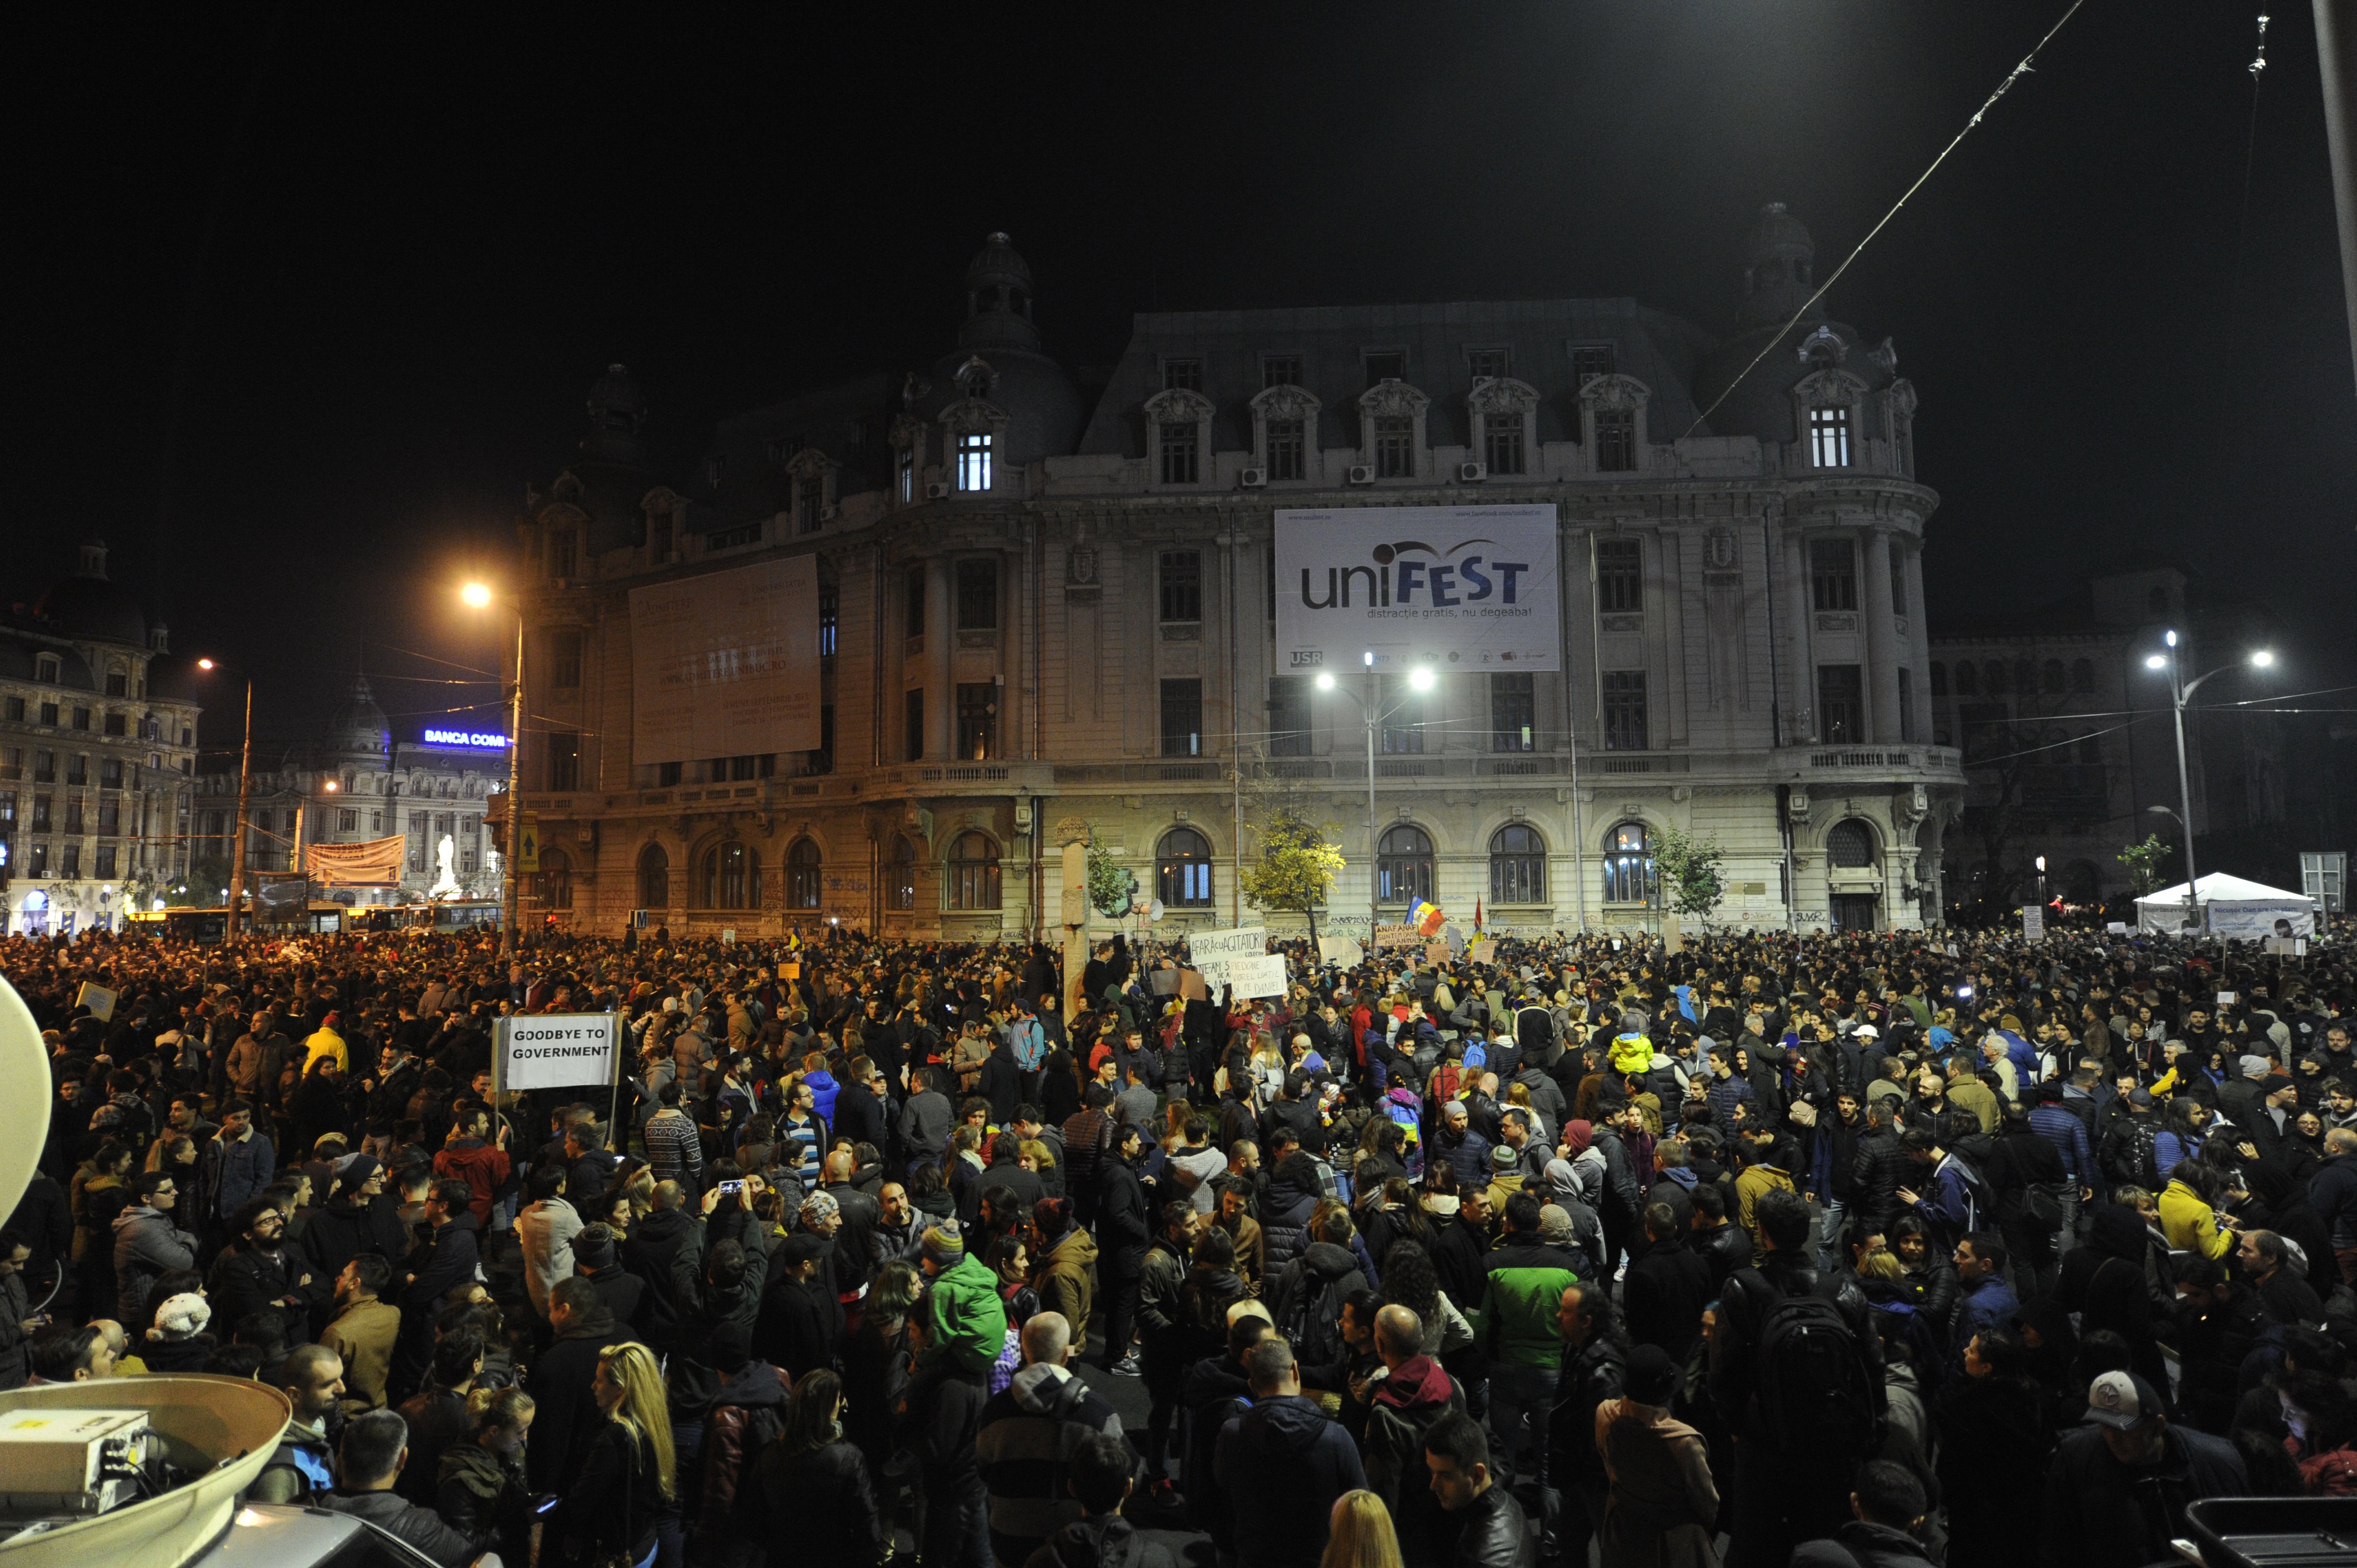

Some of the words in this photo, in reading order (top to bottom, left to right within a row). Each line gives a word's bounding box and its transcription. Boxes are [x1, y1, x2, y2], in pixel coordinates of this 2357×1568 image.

[1423, 608, 1458, 619] gratis,
[1480, 607, 1532, 618] degeaba!
[1291, 652, 1322, 664] USR
[425, 730, 470, 744] BANCA
[637, 911, 647, 927] M
[1191, 937, 1216, 956] AFARĂ
[1223, 932, 1264, 952] AGITATORII
[1231, 960, 1259, 971] PIEDONE
[1232, 973, 1255, 982] VIOREL
[1244, 983, 1251, 991] PE
[1254, 978, 1284, 996] DANIEL!
[514, 1029, 581, 1041] GOODBYE
[586, 1029, 605, 1039] TO
[513, 1046, 610, 1059] GOVERNMENT
